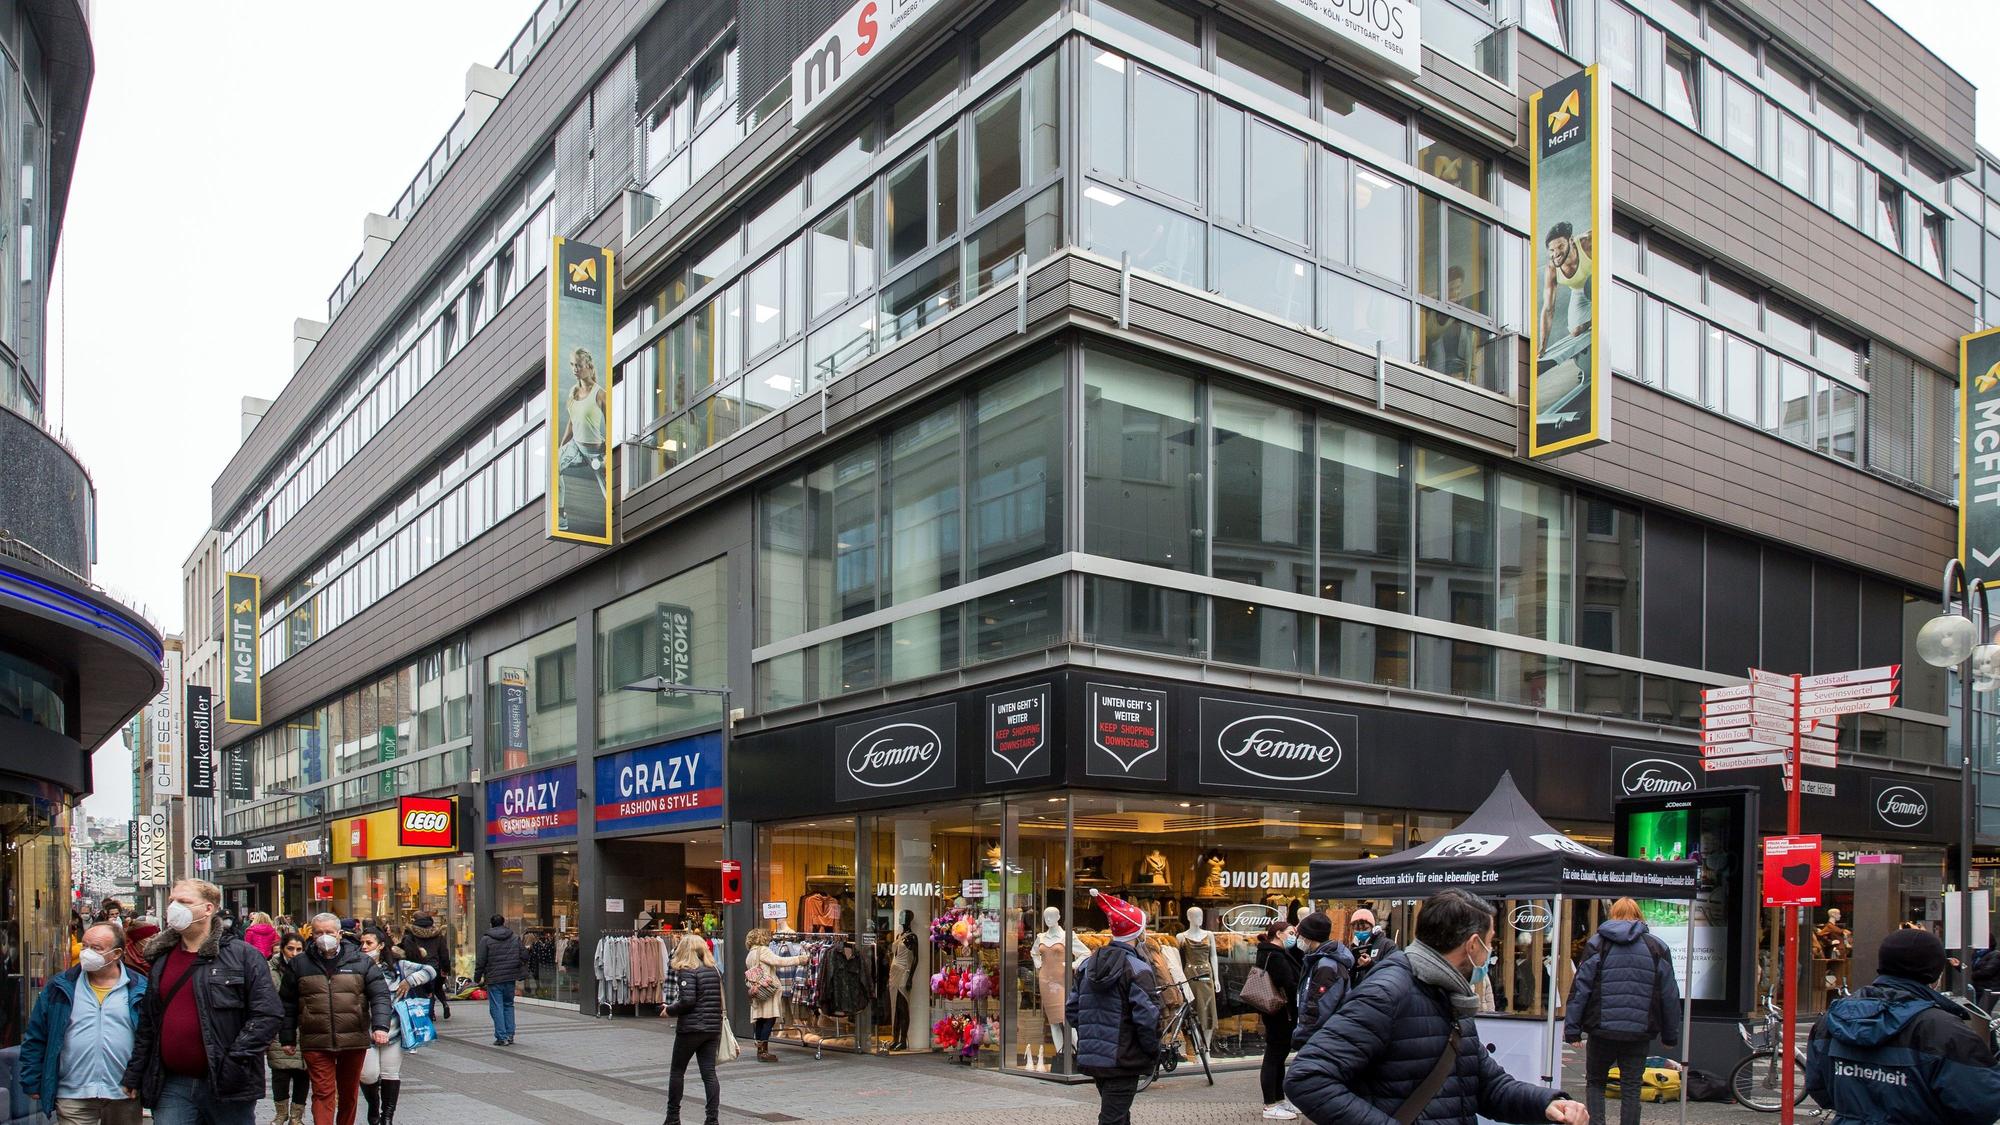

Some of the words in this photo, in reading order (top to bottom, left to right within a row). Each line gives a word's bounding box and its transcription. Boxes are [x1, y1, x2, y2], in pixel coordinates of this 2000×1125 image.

[1331, 0, 1404, 40] DIOS
[1323, 8, 1340, 22] KÖLN
[1345, 18, 1380, 43] STUTTGART
[1384, 39, 1404, 56] ESSEN
[1548, 126, 1580, 148] McFIT
[569, 283, 597, 297] McFIT
[233, 618, 252, 684] McFIT
[1814, 674, 1849, 686] Südstadt
[1814, 686, 1873, 700] Severinsviertel
[998, 702, 1016, 714] UNTEN
[1102, 696, 1126, 708] UNTEN
[1813, 702, 1872, 715] Chlodwigplatz
[1007, 712, 1028, 725] WEITER
[1114, 710, 1140, 722] WEITER
[995, 729, 1009, 740] KEEP
[1012, 723, 1041, 737] SHOPPING
[1099, 722, 1118, 733] KEEP
[1120, 724, 1155, 737] SHOPPING
[193, 695, 210, 789] hunkemöller
[999, 737, 1036, 752] DOWNSTAIRS
[1105, 735, 1150, 749] DOWNSTAIRS
[1716, 745, 1734, 754] Dom
[1715, 756, 1769, 768] Hauptbahnhof
[620, 752, 700, 798] CRAZY
[503, 780, 560, 816] CRAZY
[620, 799, 657, 816] FASHION
[659, 798, 666, 810] &
[667, 793, 699, 809] STYLE
[405, 811, 449, 832] LEGO
[503, 817, 531, 831] FASHION
[536, 814, 559, 828] STYLE
[139, 821, 152, 881] MANGO
[153, 813, 166, 878] MANGO
[1357, 874, 1396, 885] Gemeinsam
[1396, 873, 1414, 884] aktiv
[1416, 872, 1427, 883] für
[1427, 872, 1443, 883] eine
[1444, 871, 1480, 884] lebendige
[1481, 870, 1499, 882] Erde
